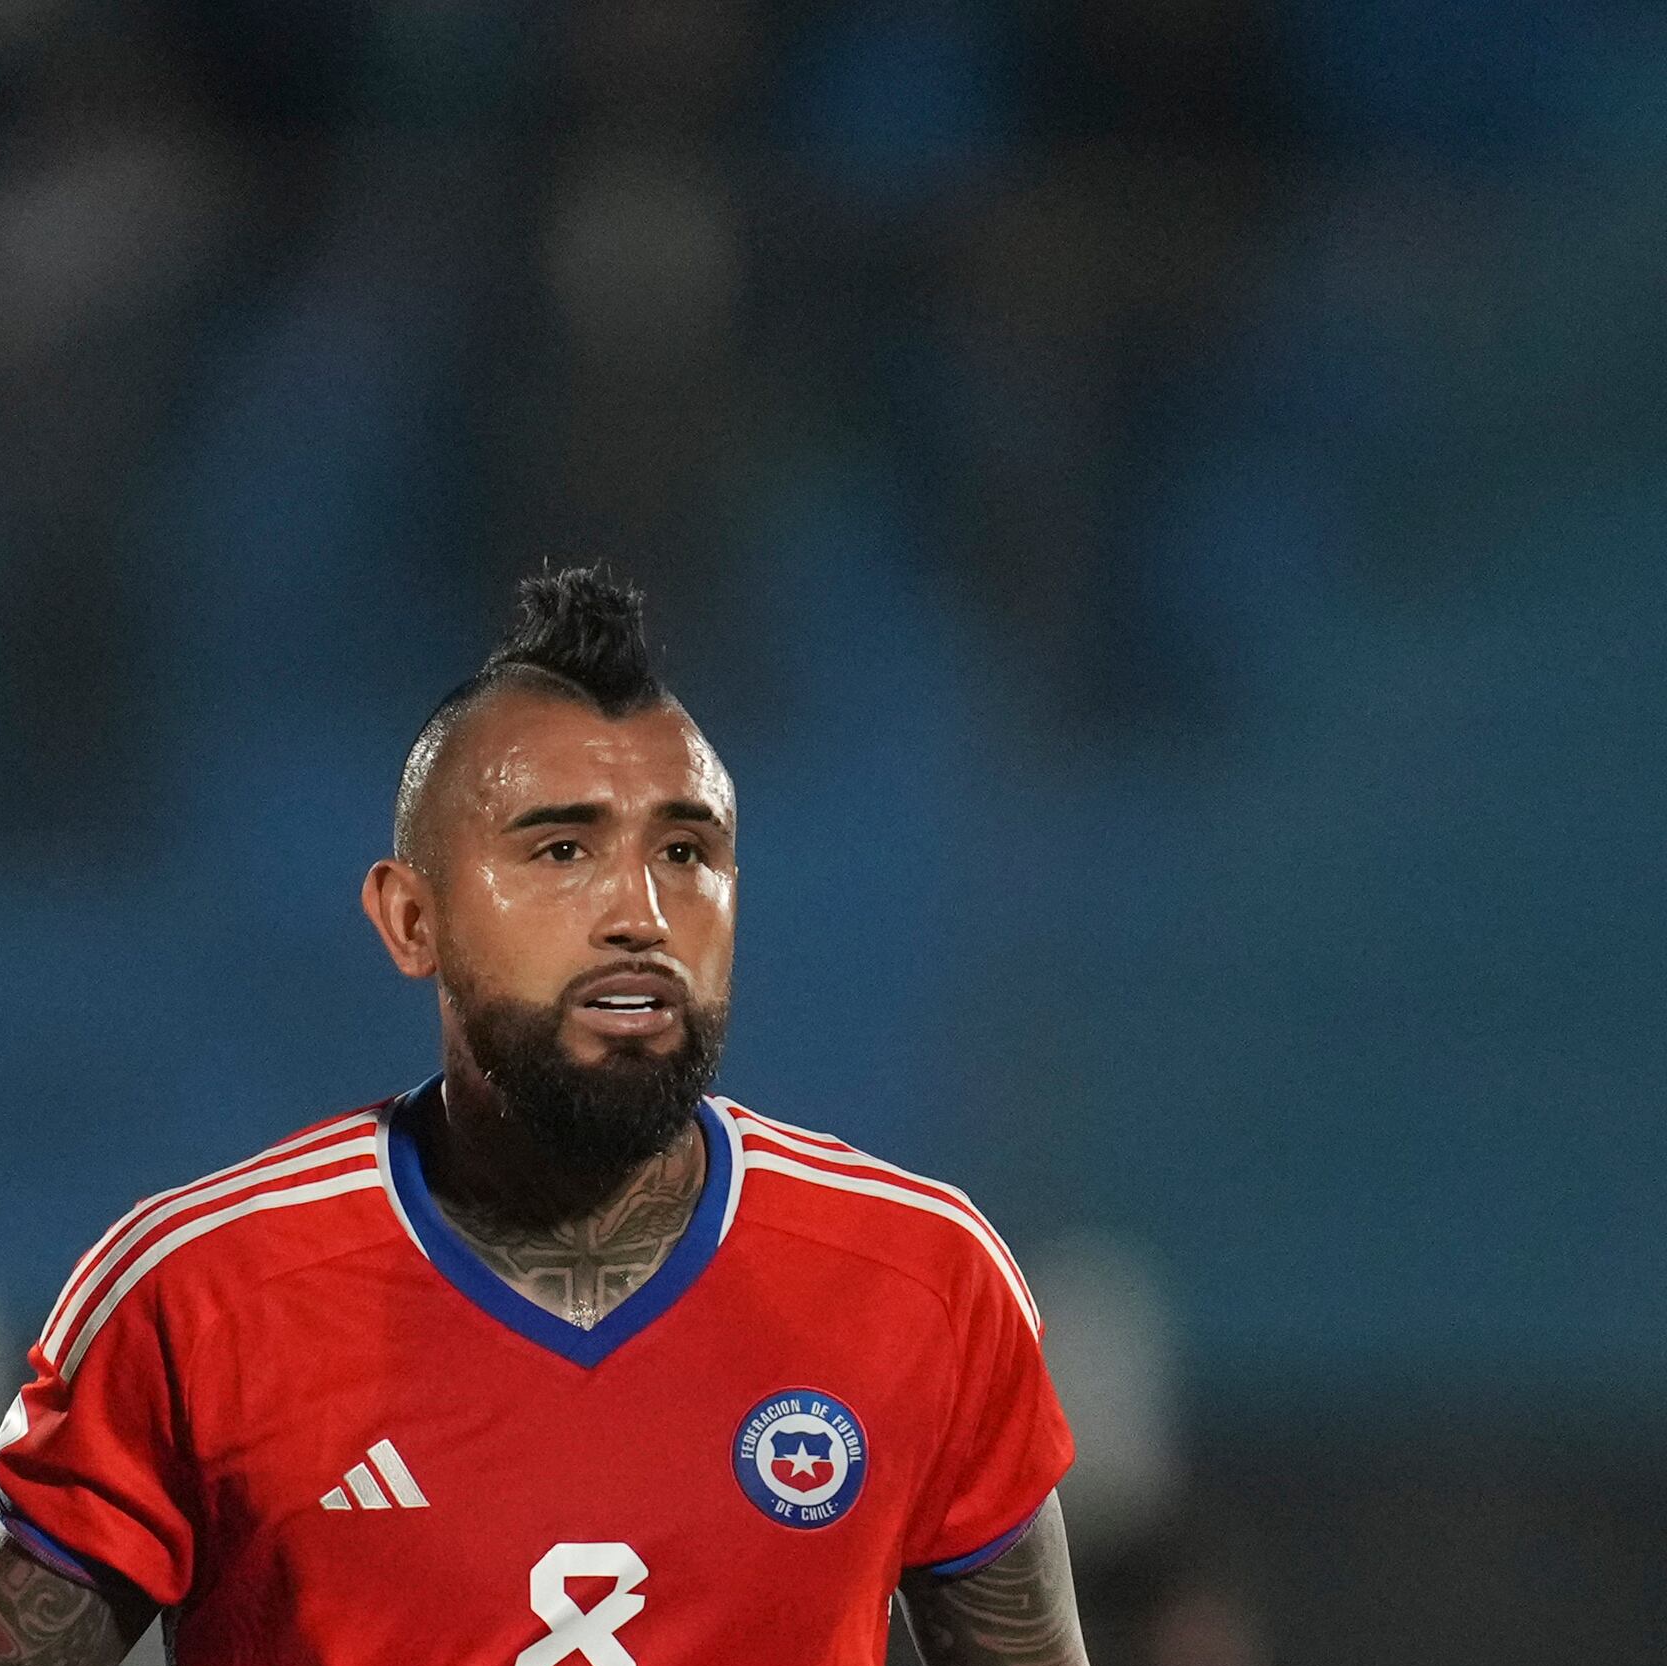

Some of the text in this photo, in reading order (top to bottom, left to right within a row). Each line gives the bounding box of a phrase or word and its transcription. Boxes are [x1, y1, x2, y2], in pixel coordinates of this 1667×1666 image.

[740, 1399, 863, 1465] FEDERACION DE FUTBOL
[774, 1500, 837, 1521] DE CHILE
